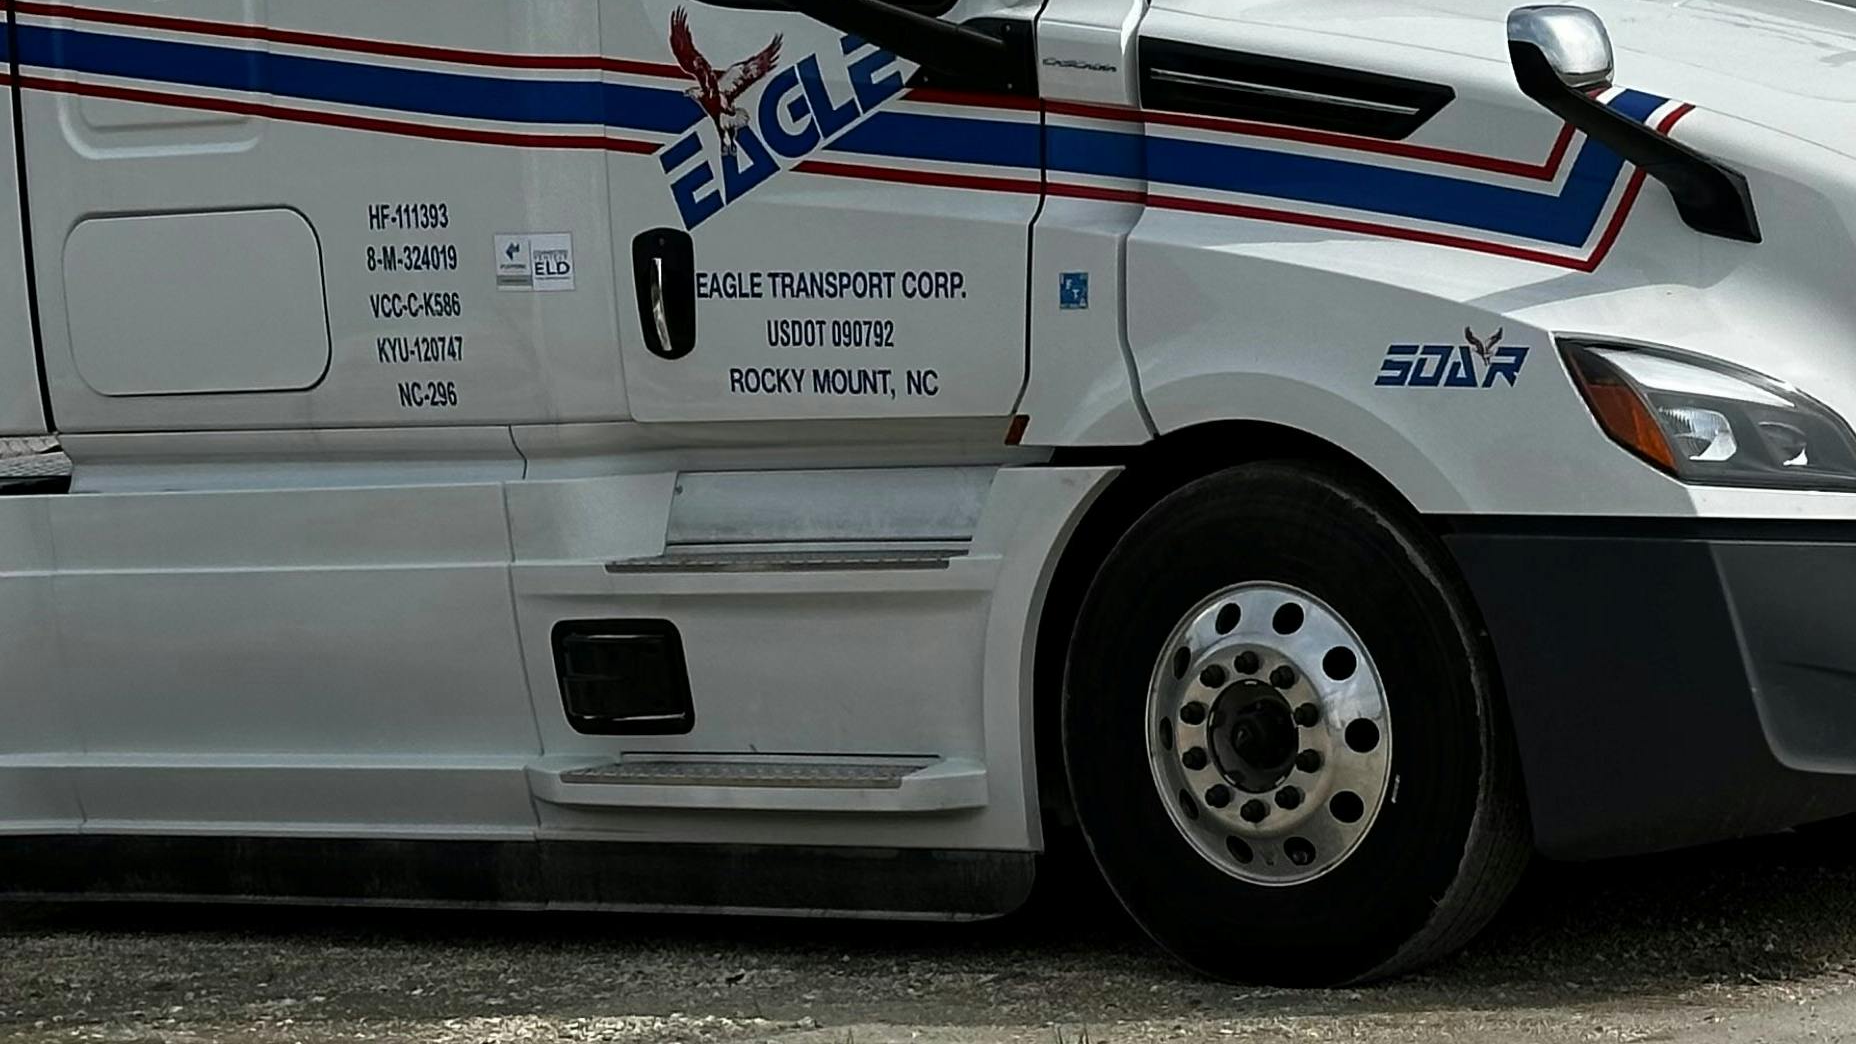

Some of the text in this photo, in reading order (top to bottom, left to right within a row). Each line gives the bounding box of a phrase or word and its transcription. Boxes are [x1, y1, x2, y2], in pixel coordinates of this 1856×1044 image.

[659, 33, 904, 231] EAGLE
[368, 203, 449, 230] HF-111393
[366, 244, 457, 271] 8-M-324019
[535, 261, 570, 276] ELD
[696, 271, 967, 299] EAGLE TRANSPORT CORP.
[370, 292, 461, 318] VCC-C-K586
[767, 319, 895, 347] USDOT 090792
[377, 336, 462, 363] KYU-120747
[1374, 344, 1530, 388] SOAR
[398, 382, 458, 407] NC-296
[729, 368, 939, 399] ROCKY MOUNT, NC
